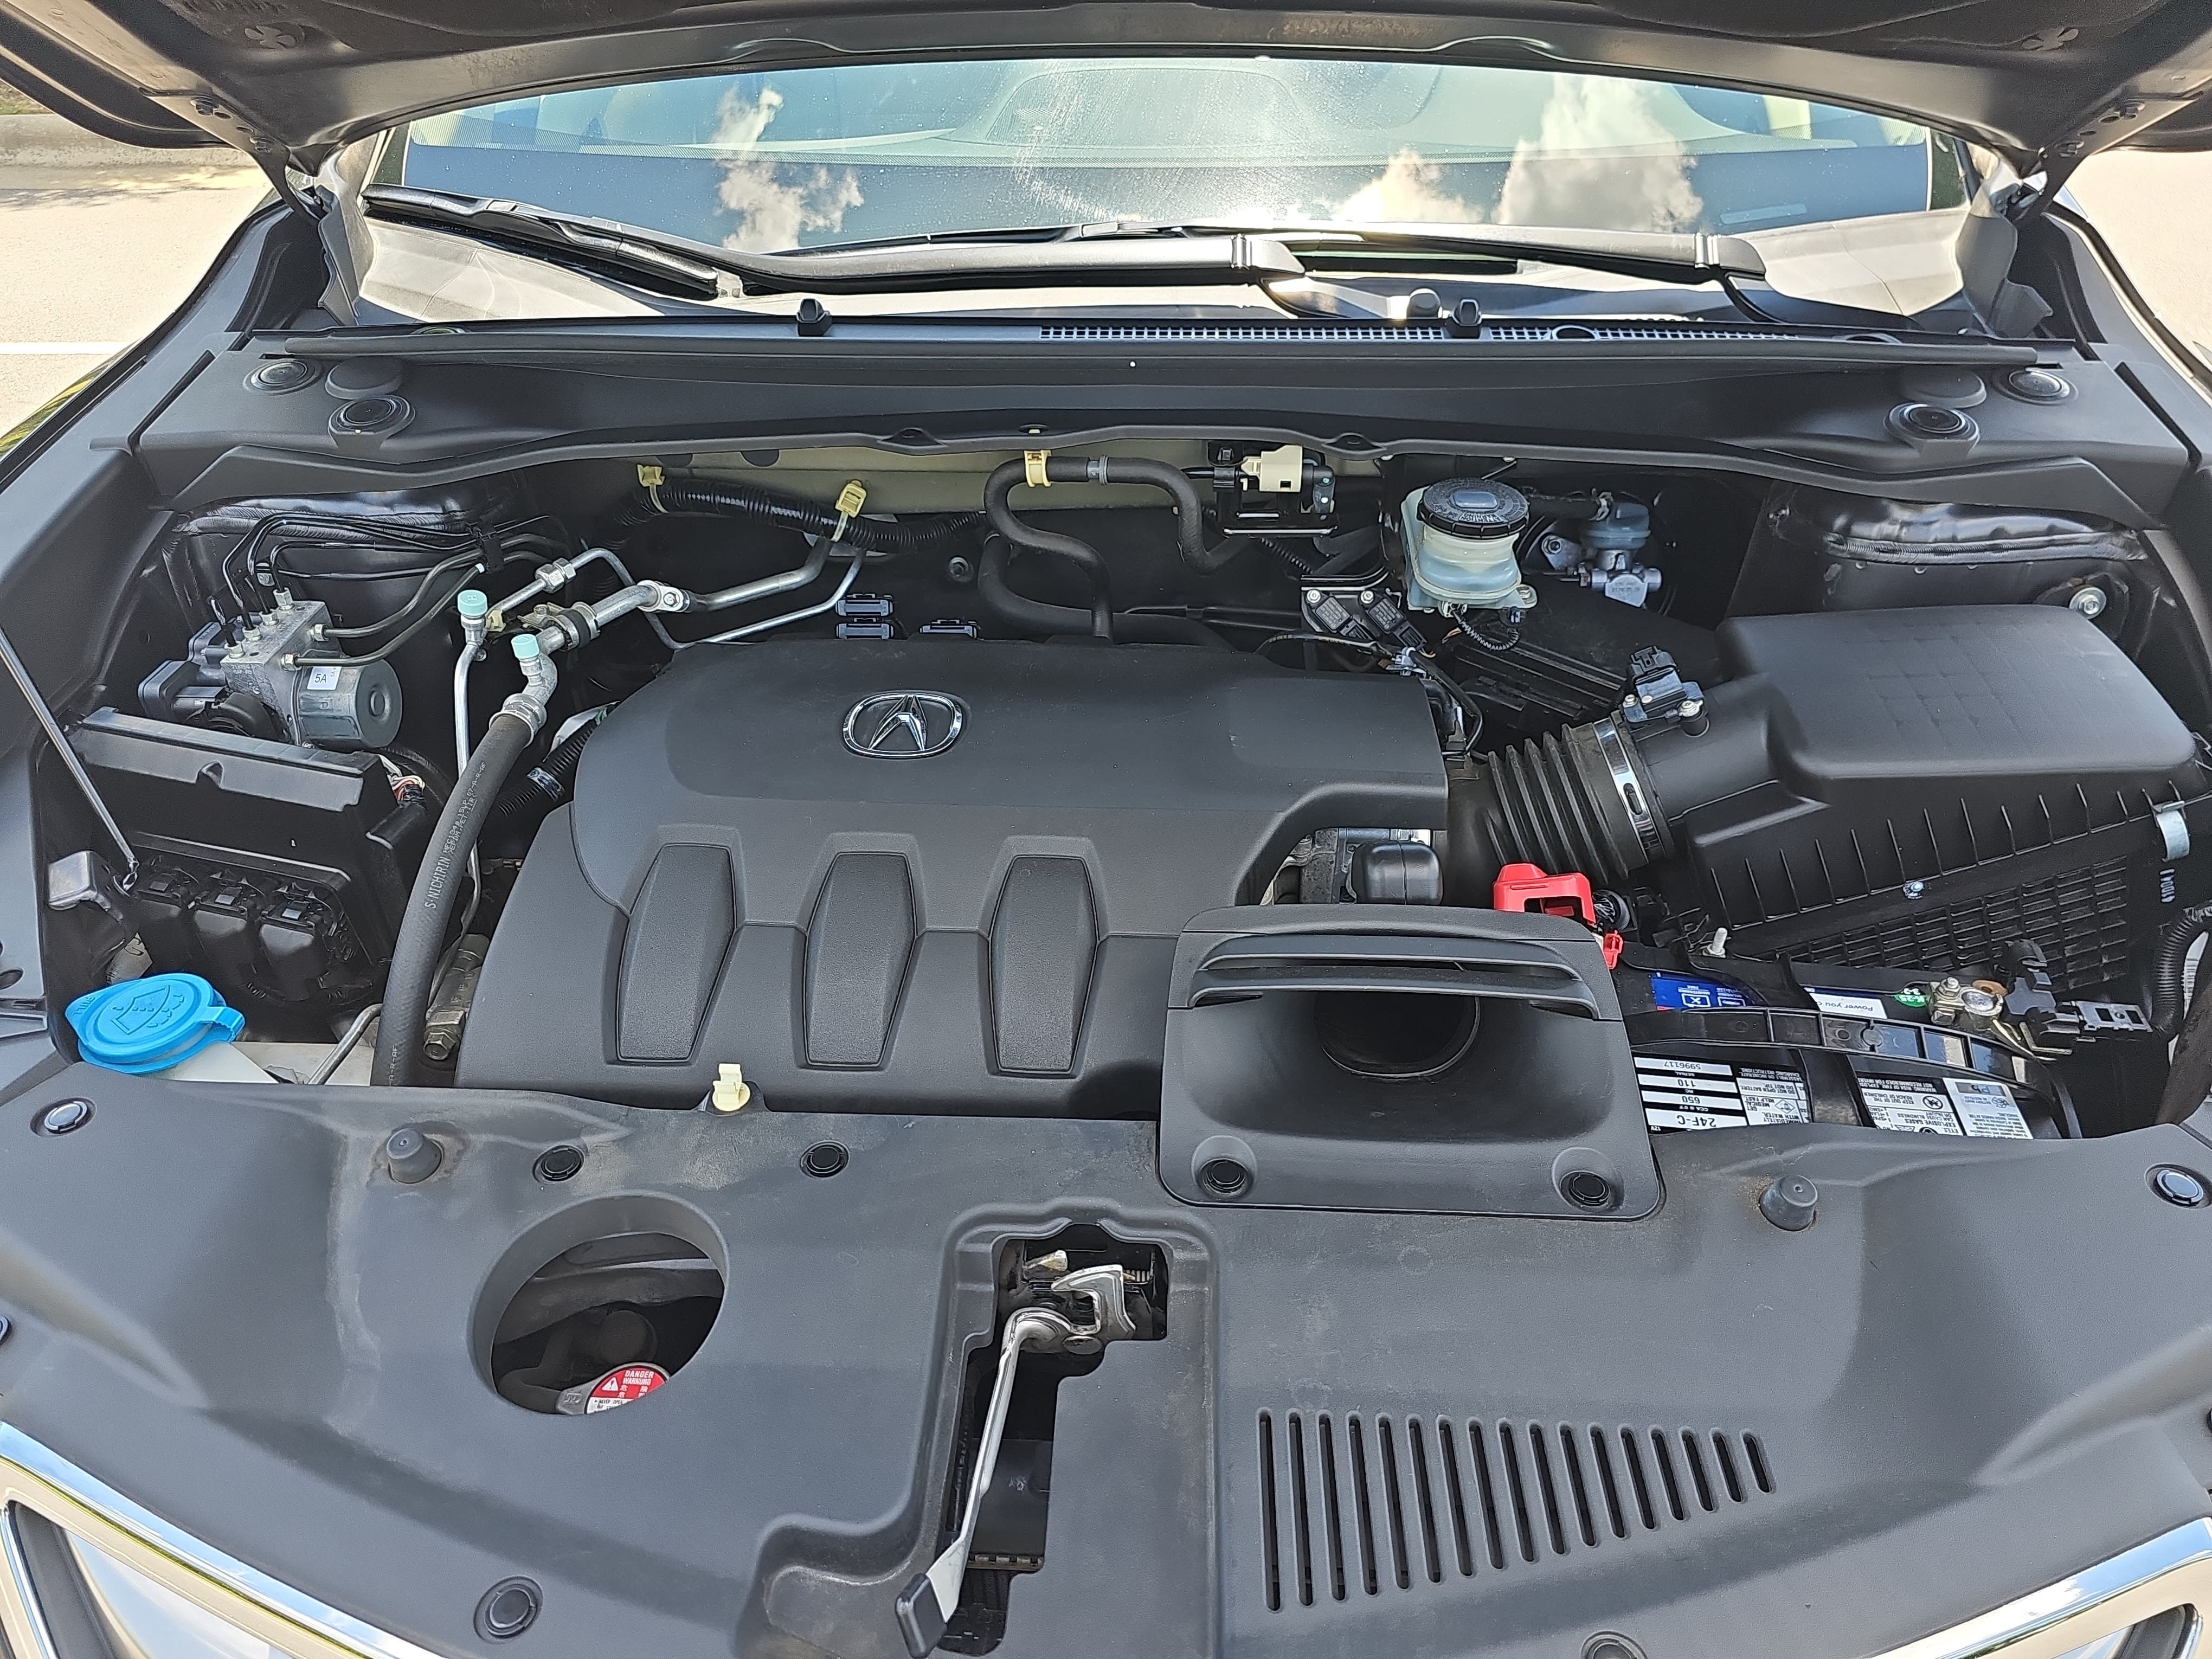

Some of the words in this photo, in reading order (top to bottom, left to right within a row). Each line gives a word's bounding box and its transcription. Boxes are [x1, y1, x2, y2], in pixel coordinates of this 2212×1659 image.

[314, 673, 326, 683] 5A
[1899, 995, 1925, 1003] K-25
[71, 996, 96, 1015] PULL
[1664, 1061, 1701, 1070] 5996117
[1971, 1085, 1991, 1095] Pb
[1681, 1096, 1701, 1104] 650
[1676, 1115, 1716, 1128] 24F-C
[1924, 1120, 1956, 1128] EXPLOSIVE
